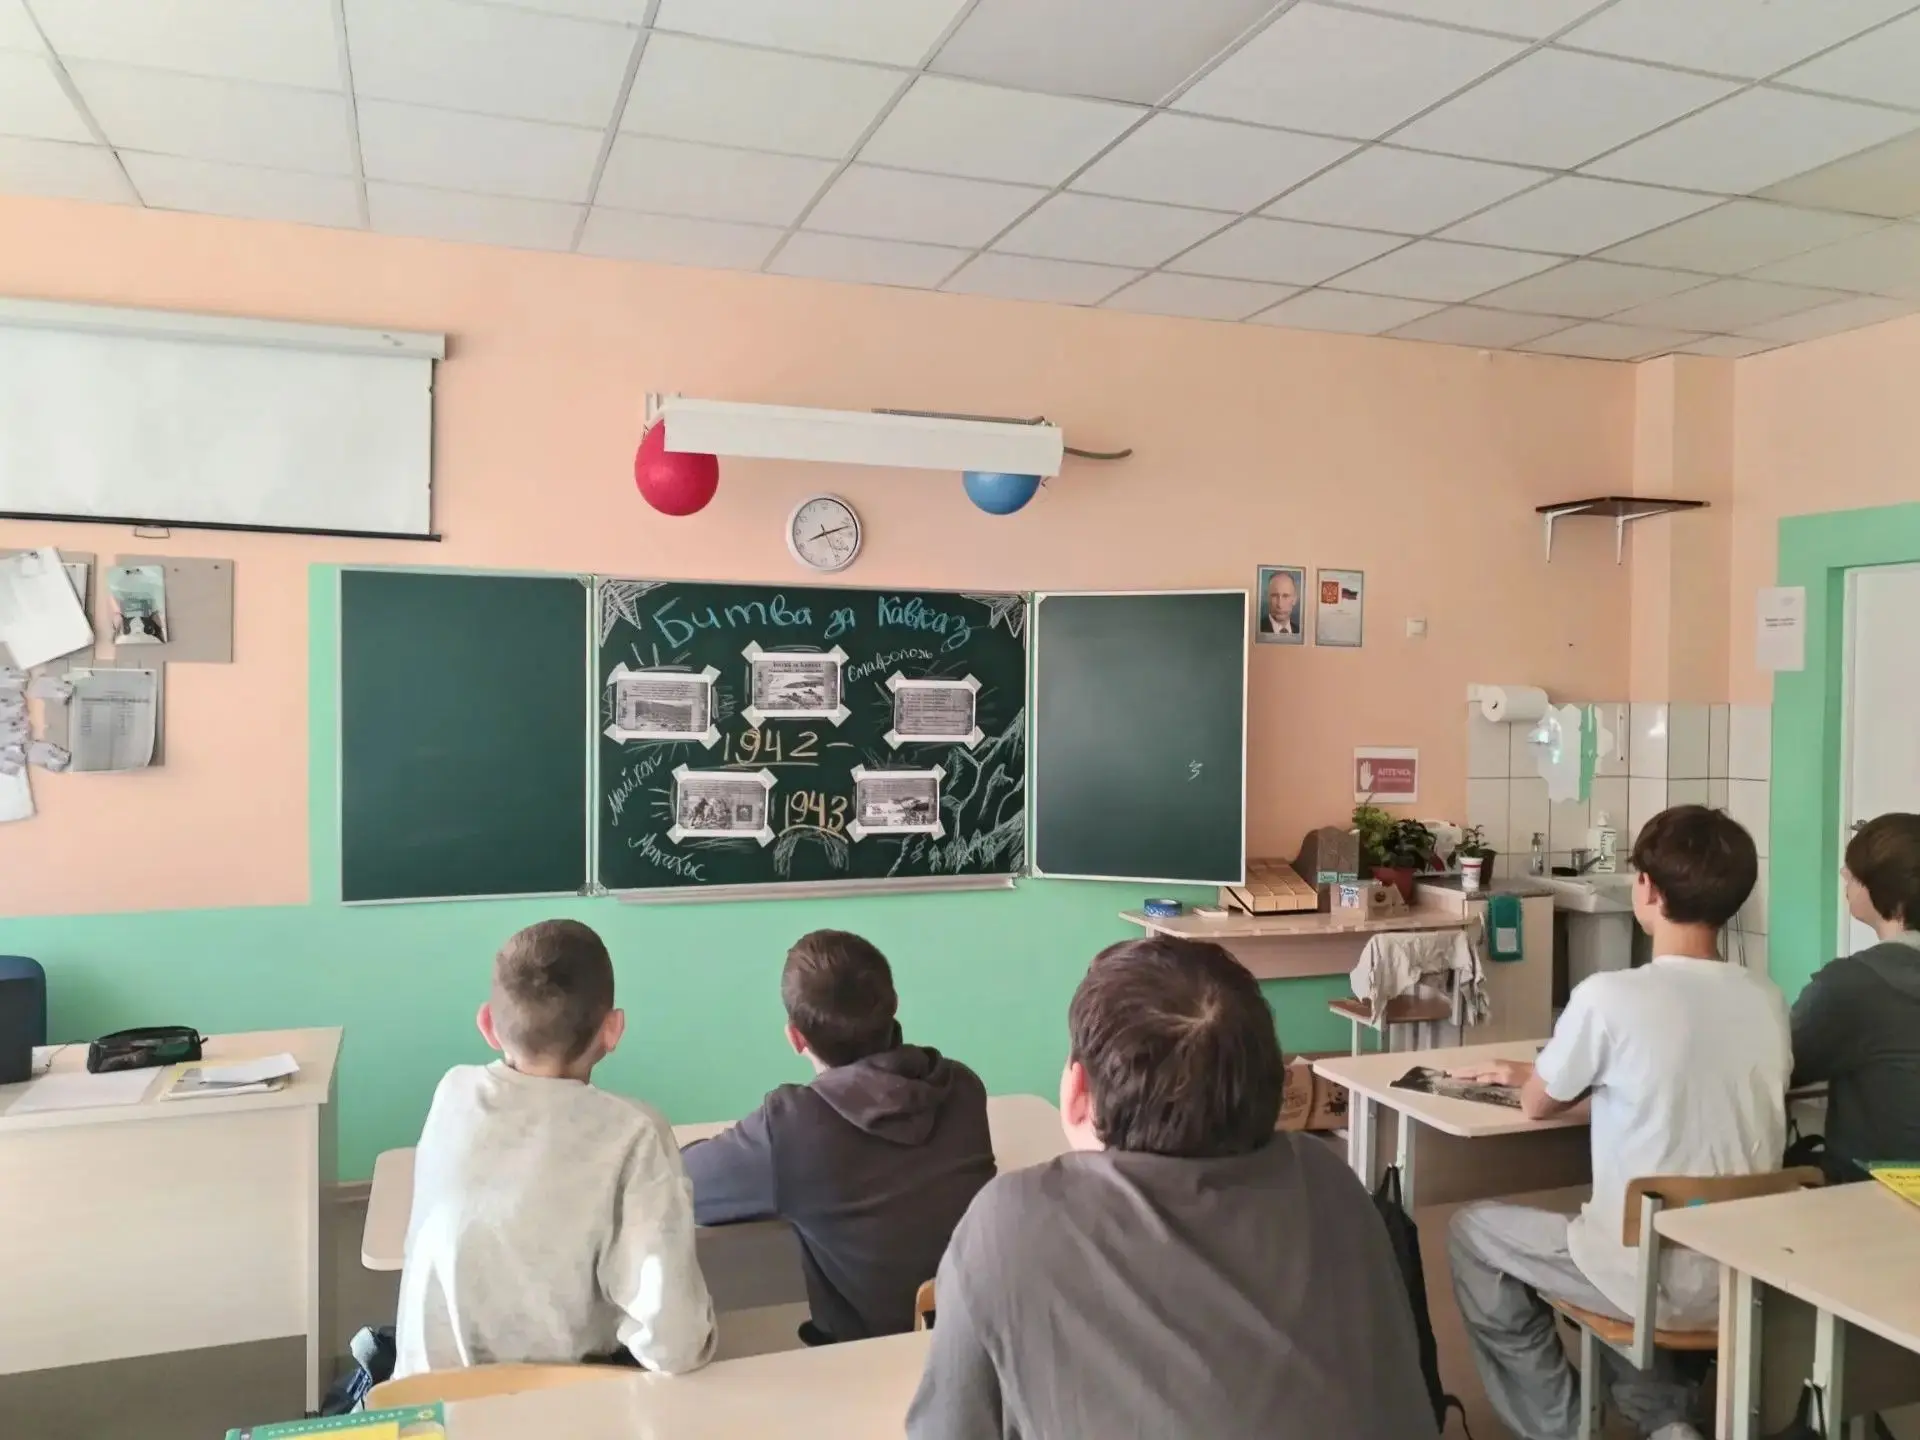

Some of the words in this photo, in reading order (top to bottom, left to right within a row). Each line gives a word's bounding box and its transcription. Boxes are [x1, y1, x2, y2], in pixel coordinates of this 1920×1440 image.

[652, 594, 812, 648] Битва
[824, 607, 856, 639] за
[878, 596, 973, 653] Кавказ
[784, 790, 849, 833] 1943
